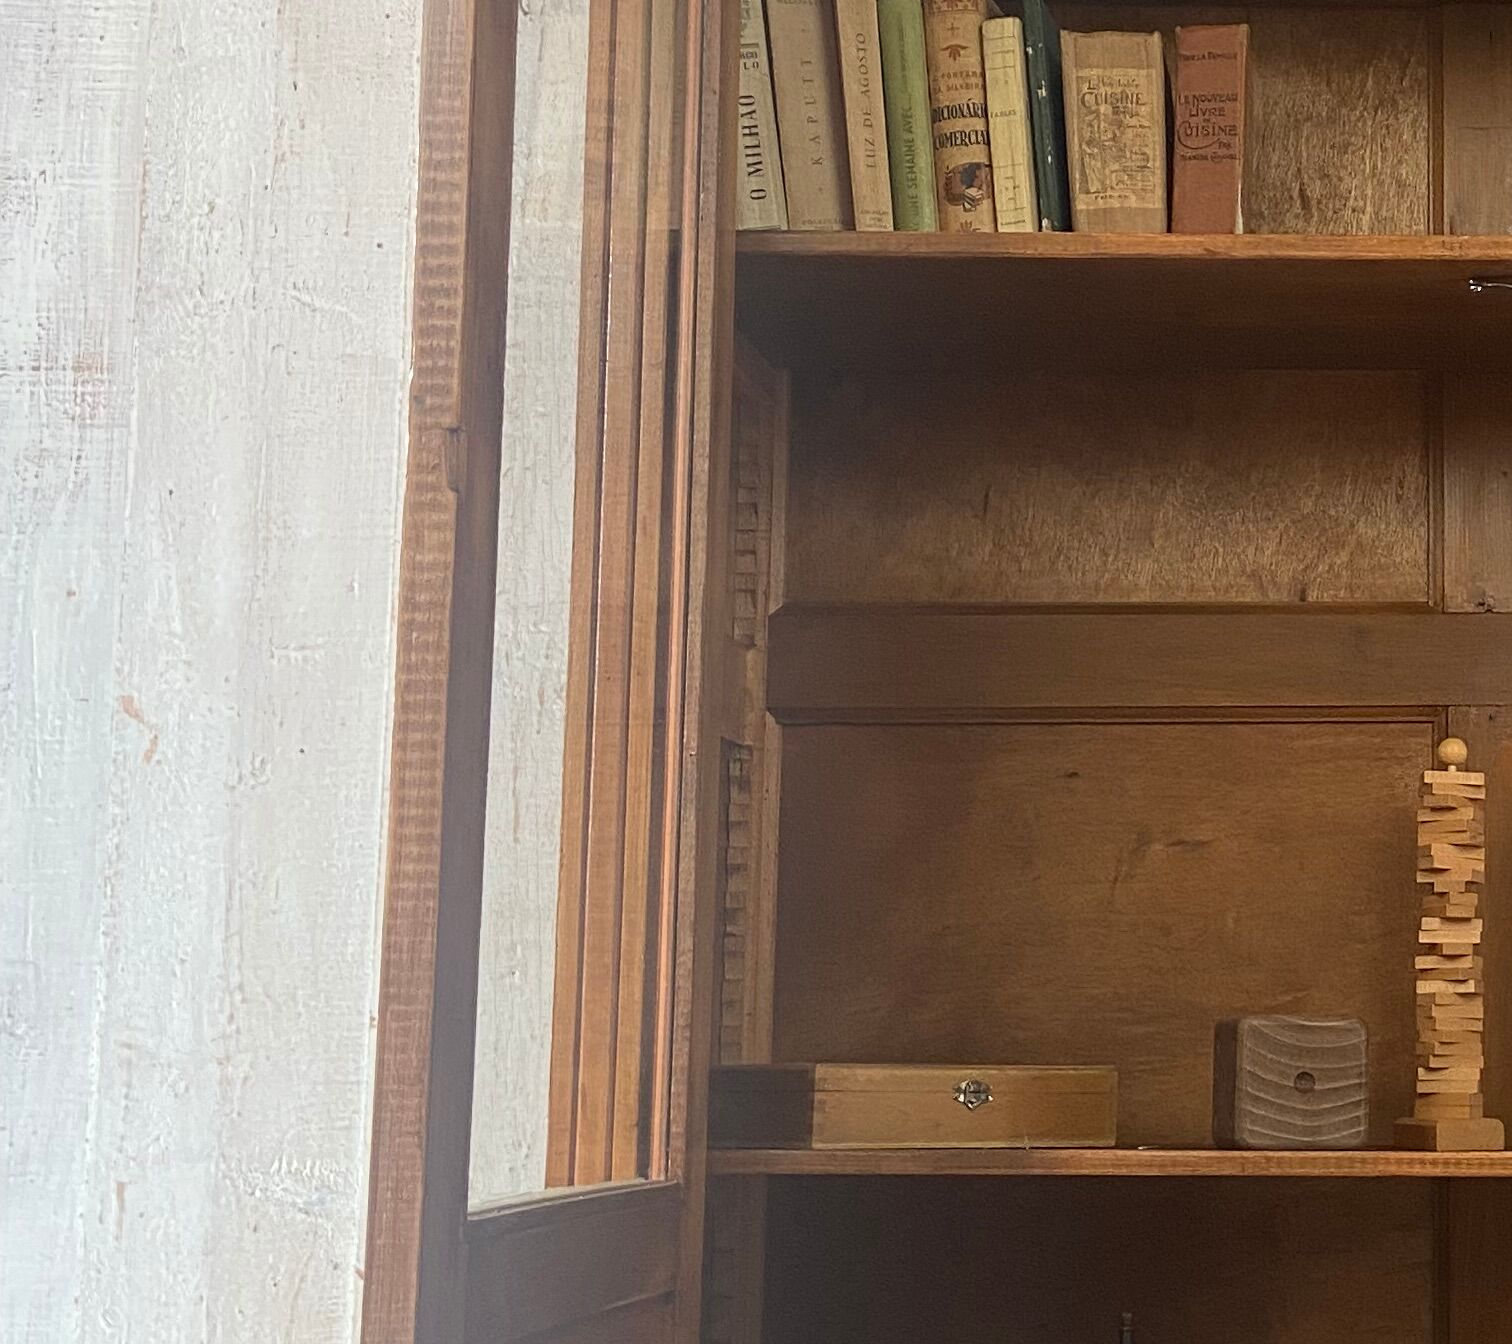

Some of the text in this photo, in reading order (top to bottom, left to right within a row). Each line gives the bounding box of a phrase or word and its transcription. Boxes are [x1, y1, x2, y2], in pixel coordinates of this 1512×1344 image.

[800, 60, 824, 166] KAPUTT
[855, 32, 877, 169] LUZ DE AGOSTO
[1189, 107, 1226, 117] LIVRE
[1192, 93, 1238, 107] NOUVEAU
[903, 138, 918, 190] SEMAINE
[749, 188, 767, 200] O
